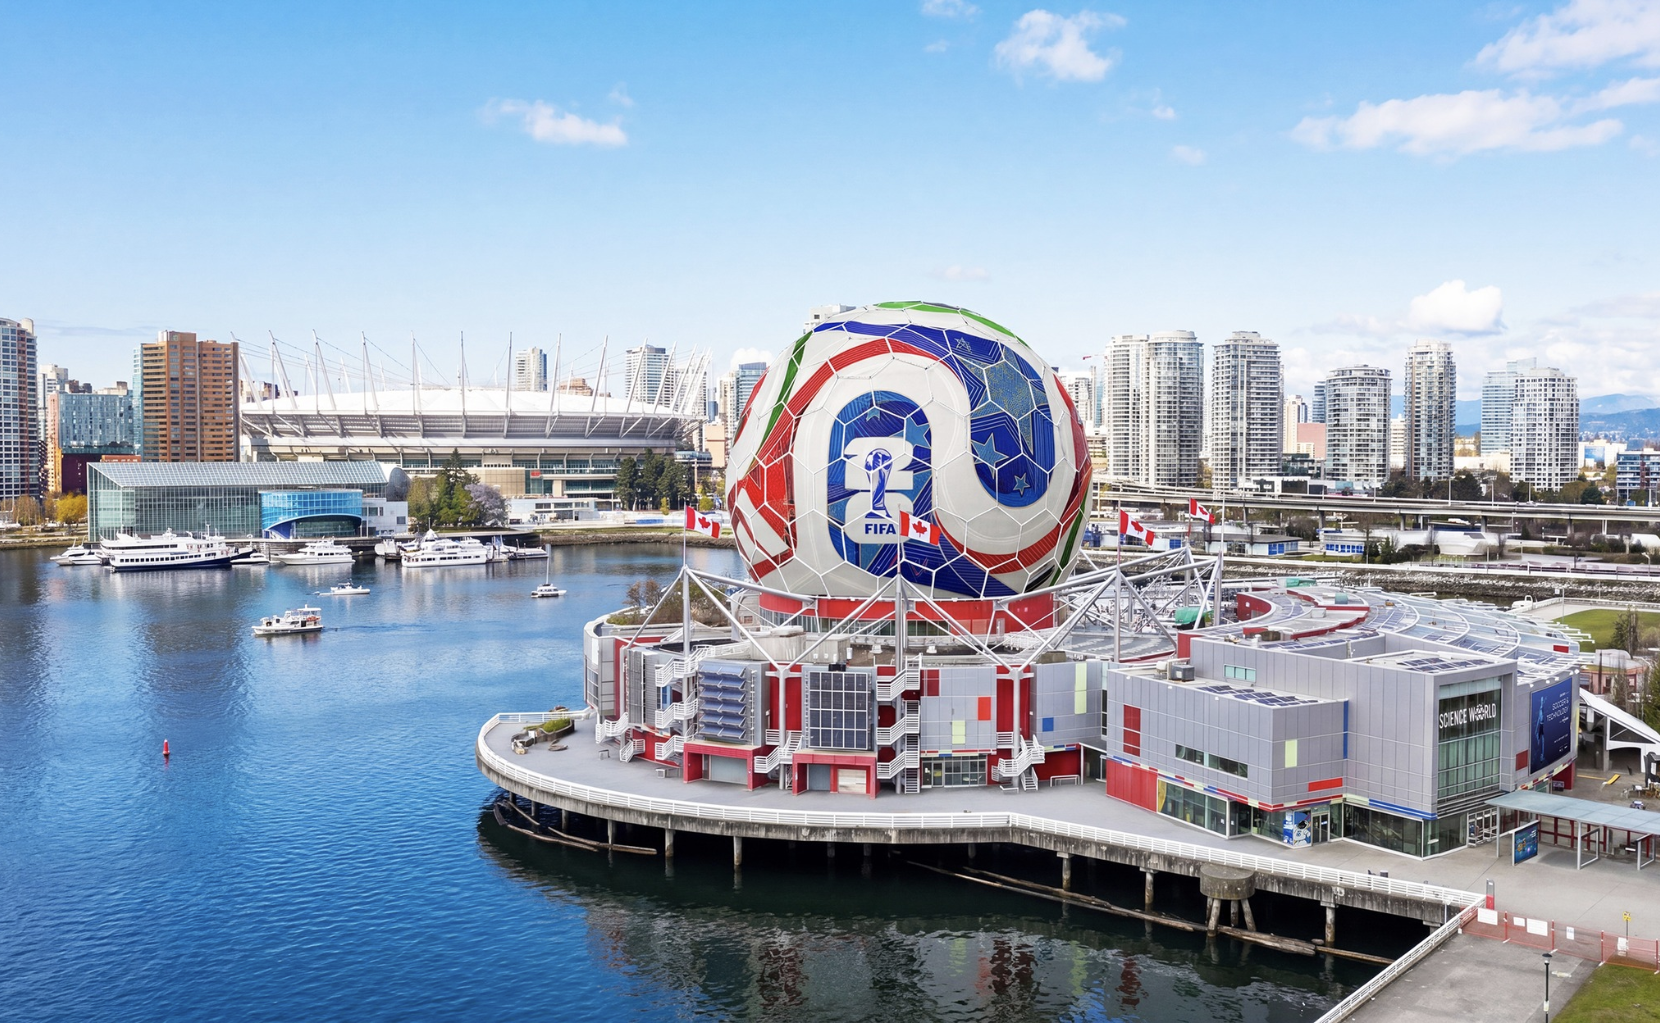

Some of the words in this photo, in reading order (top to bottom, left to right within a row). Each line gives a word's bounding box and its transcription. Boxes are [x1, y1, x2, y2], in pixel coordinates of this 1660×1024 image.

[864, 523, 897, 535] FIFA
[1439, 708, 1467, 729] SCIENCE
[1547, 706, 1569, 721] TECHNOLOGY
